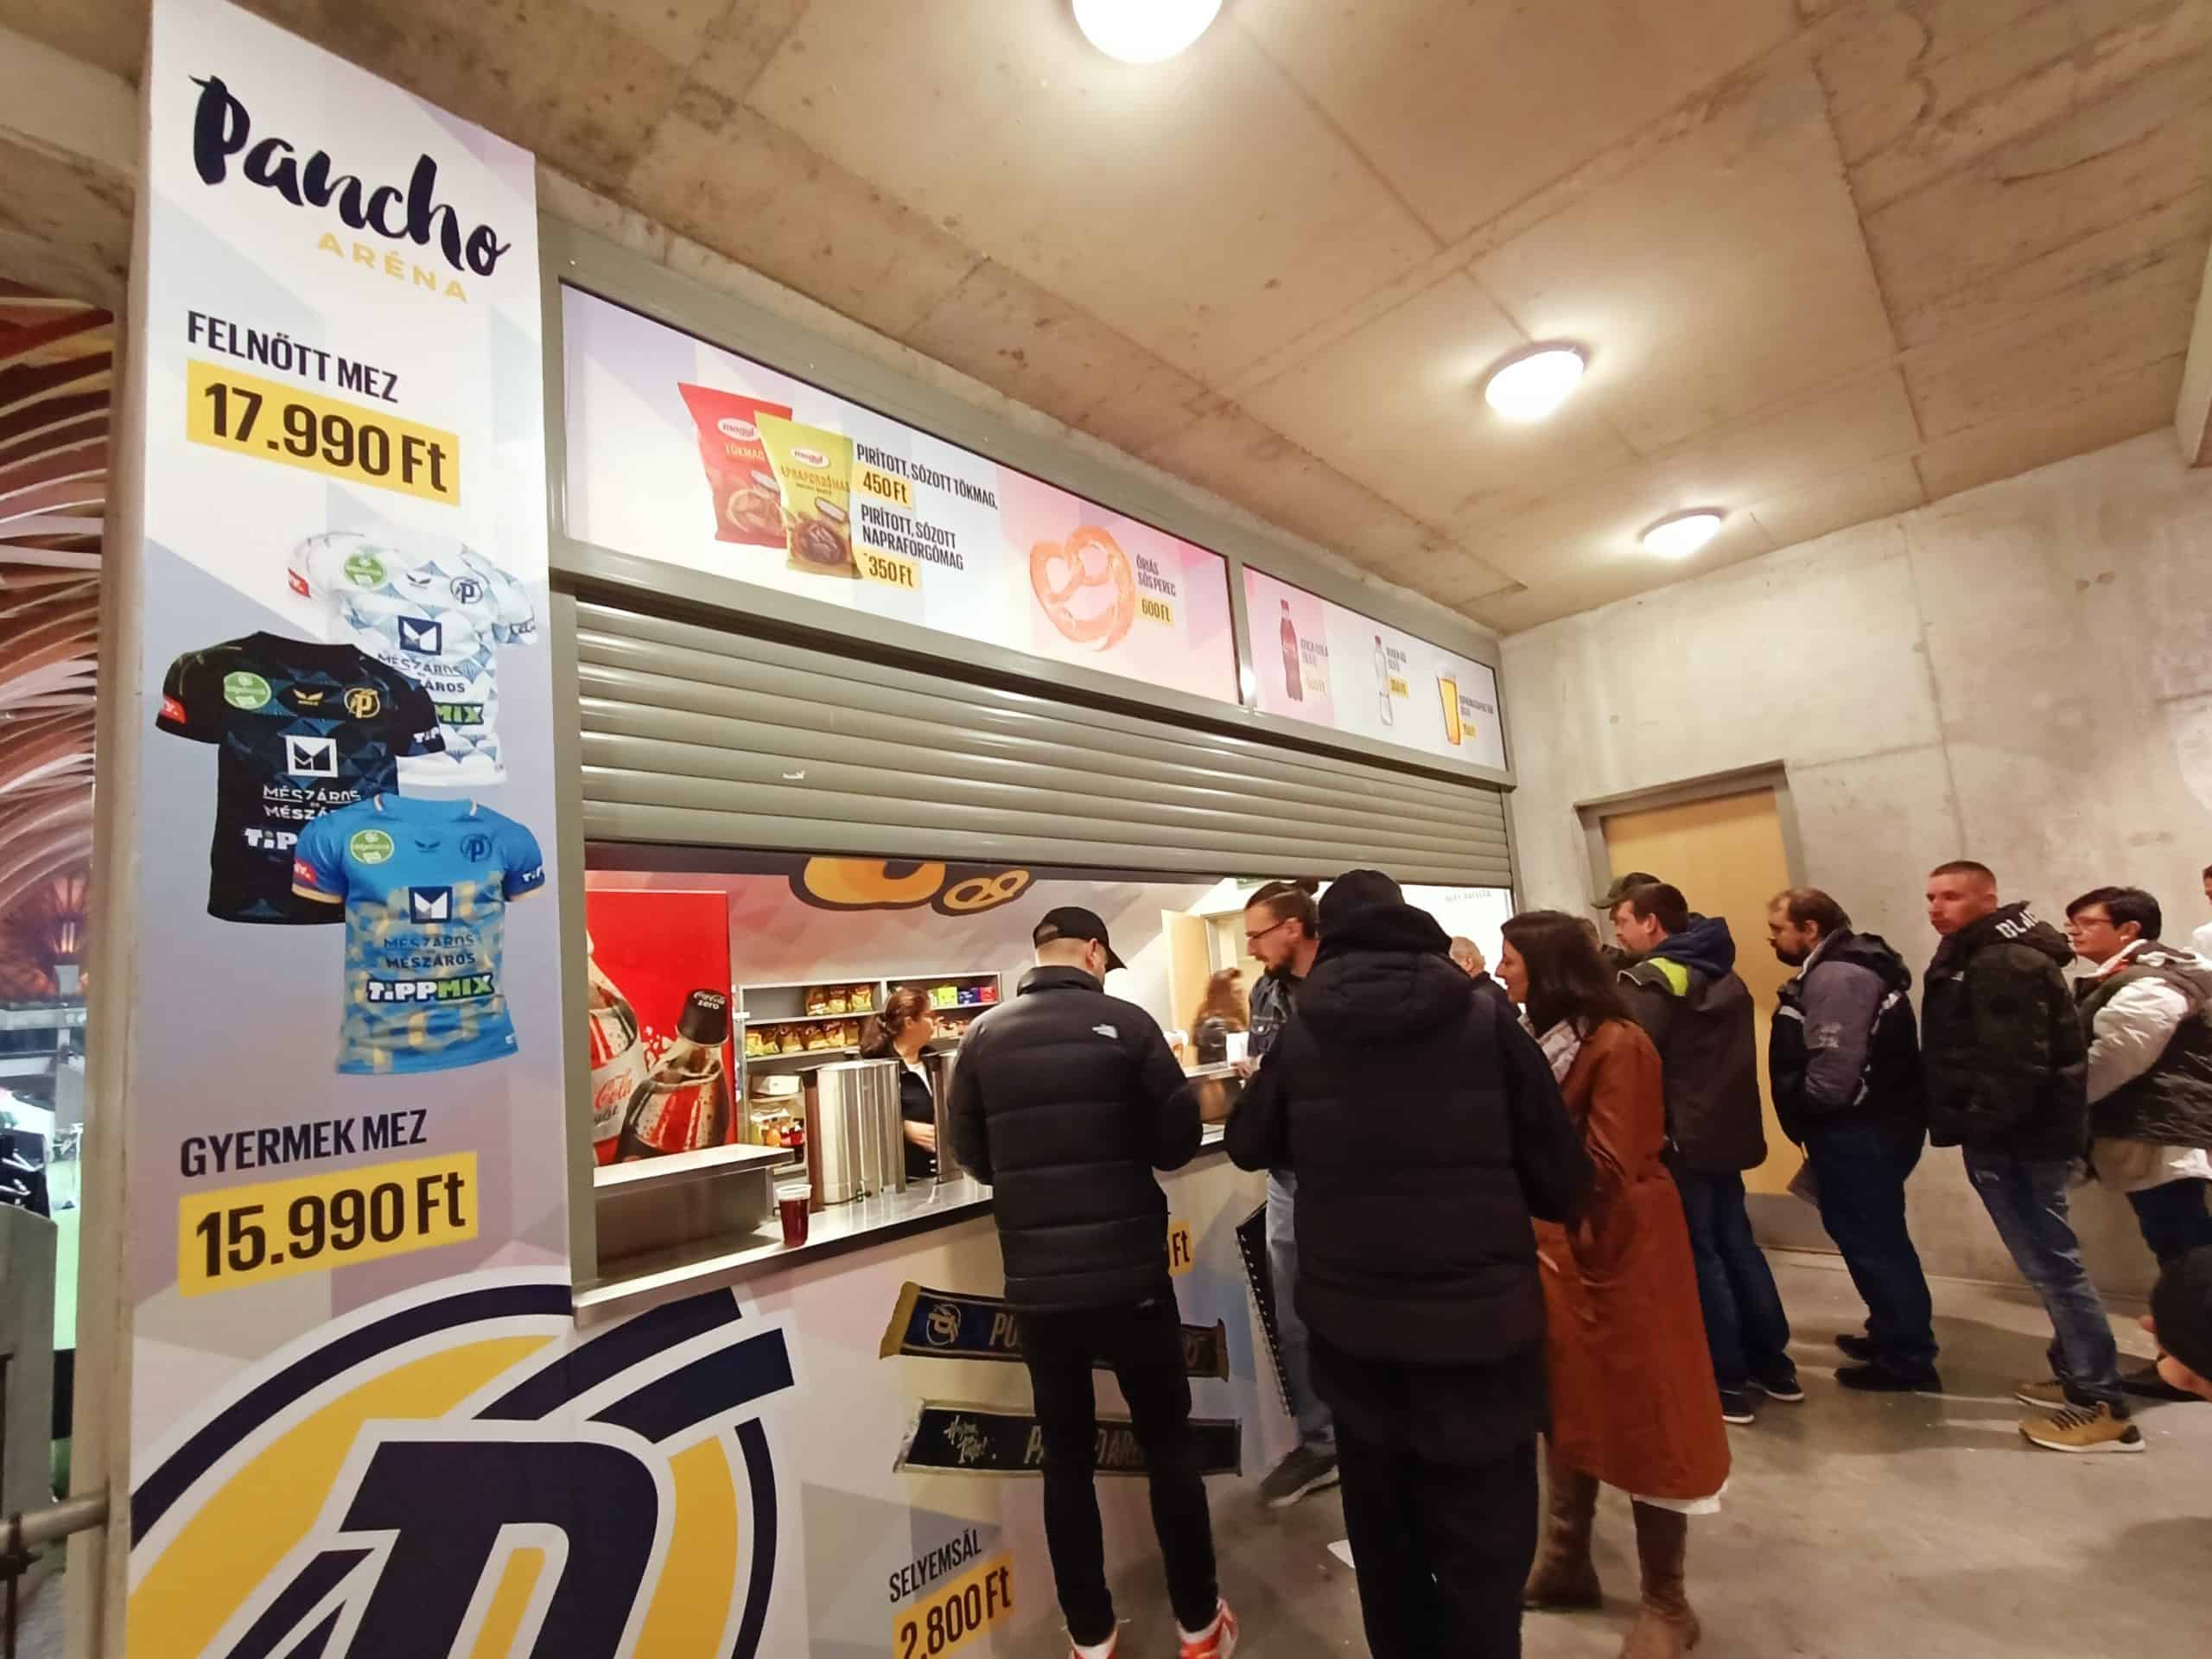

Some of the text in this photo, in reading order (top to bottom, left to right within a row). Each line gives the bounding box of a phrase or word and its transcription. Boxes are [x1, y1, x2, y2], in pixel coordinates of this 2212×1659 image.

[188, 74, 511, 276] Pancho
[318, 232, 467, 303] ARÉNA
[338, 358, 398, 404] MEZ
[204, 382, 448, 493] 17.990 Ft
[862, 471, 907, 504] 450 Ft
[862, 524, 963, 571] NAPRAFORGÓMAG
[868, 556, 913, 588] 350 Ft
[180, 1109, 428, 1178] GYERMEK MEZ
[195, 1171, 467, 1278] 15.990 Ft
[1173, 1230, 1191, 1267] Ft
[889, 1528, 982, 1603] SELYEMSÁL
[985, 1566, 1012, 1620] Ft
